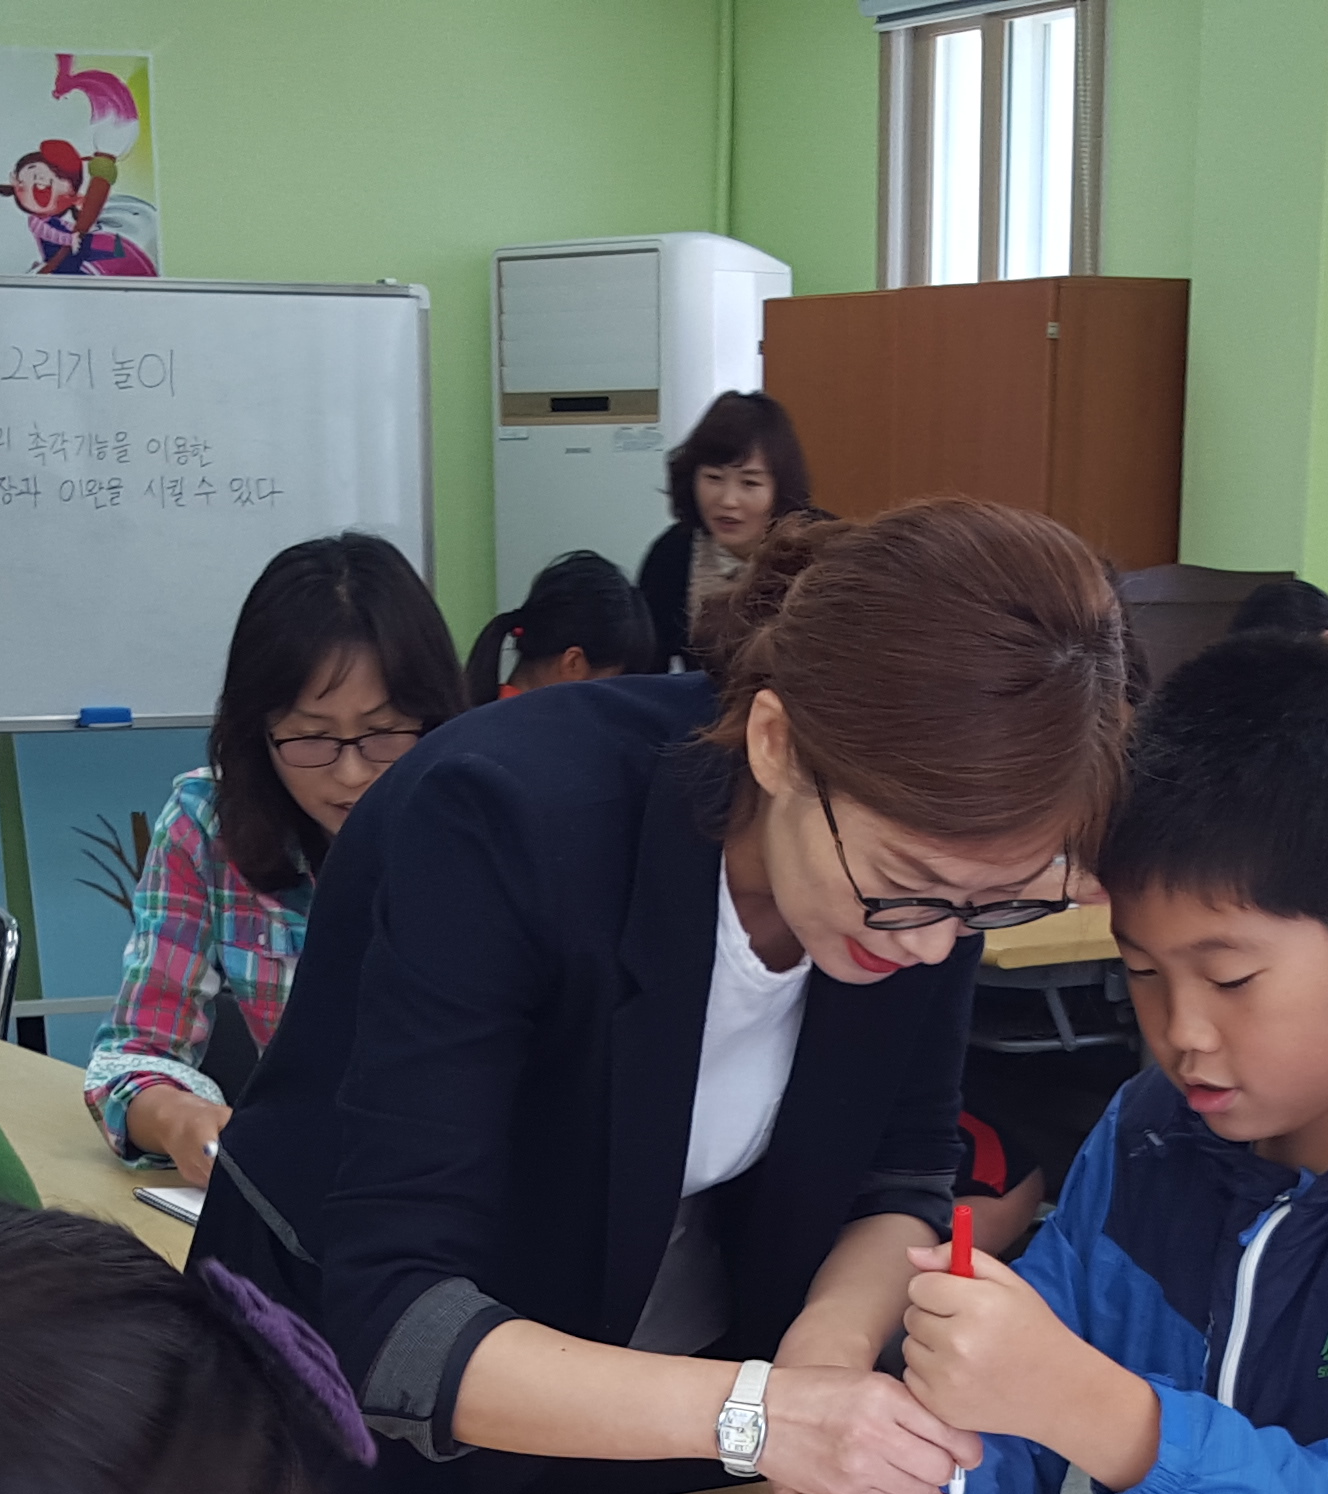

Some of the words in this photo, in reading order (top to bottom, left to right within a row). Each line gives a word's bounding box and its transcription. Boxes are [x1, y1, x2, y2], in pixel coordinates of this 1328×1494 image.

[0, 344, 94, 390] 그리기
[111, 347, 175, 398] 놀이
[146, 434, 213, 469] 이용한
[58, 476, 124, 511] 이완을
[193, 475, 218, 507] 수
[228, 476, 285, 509] 있다
